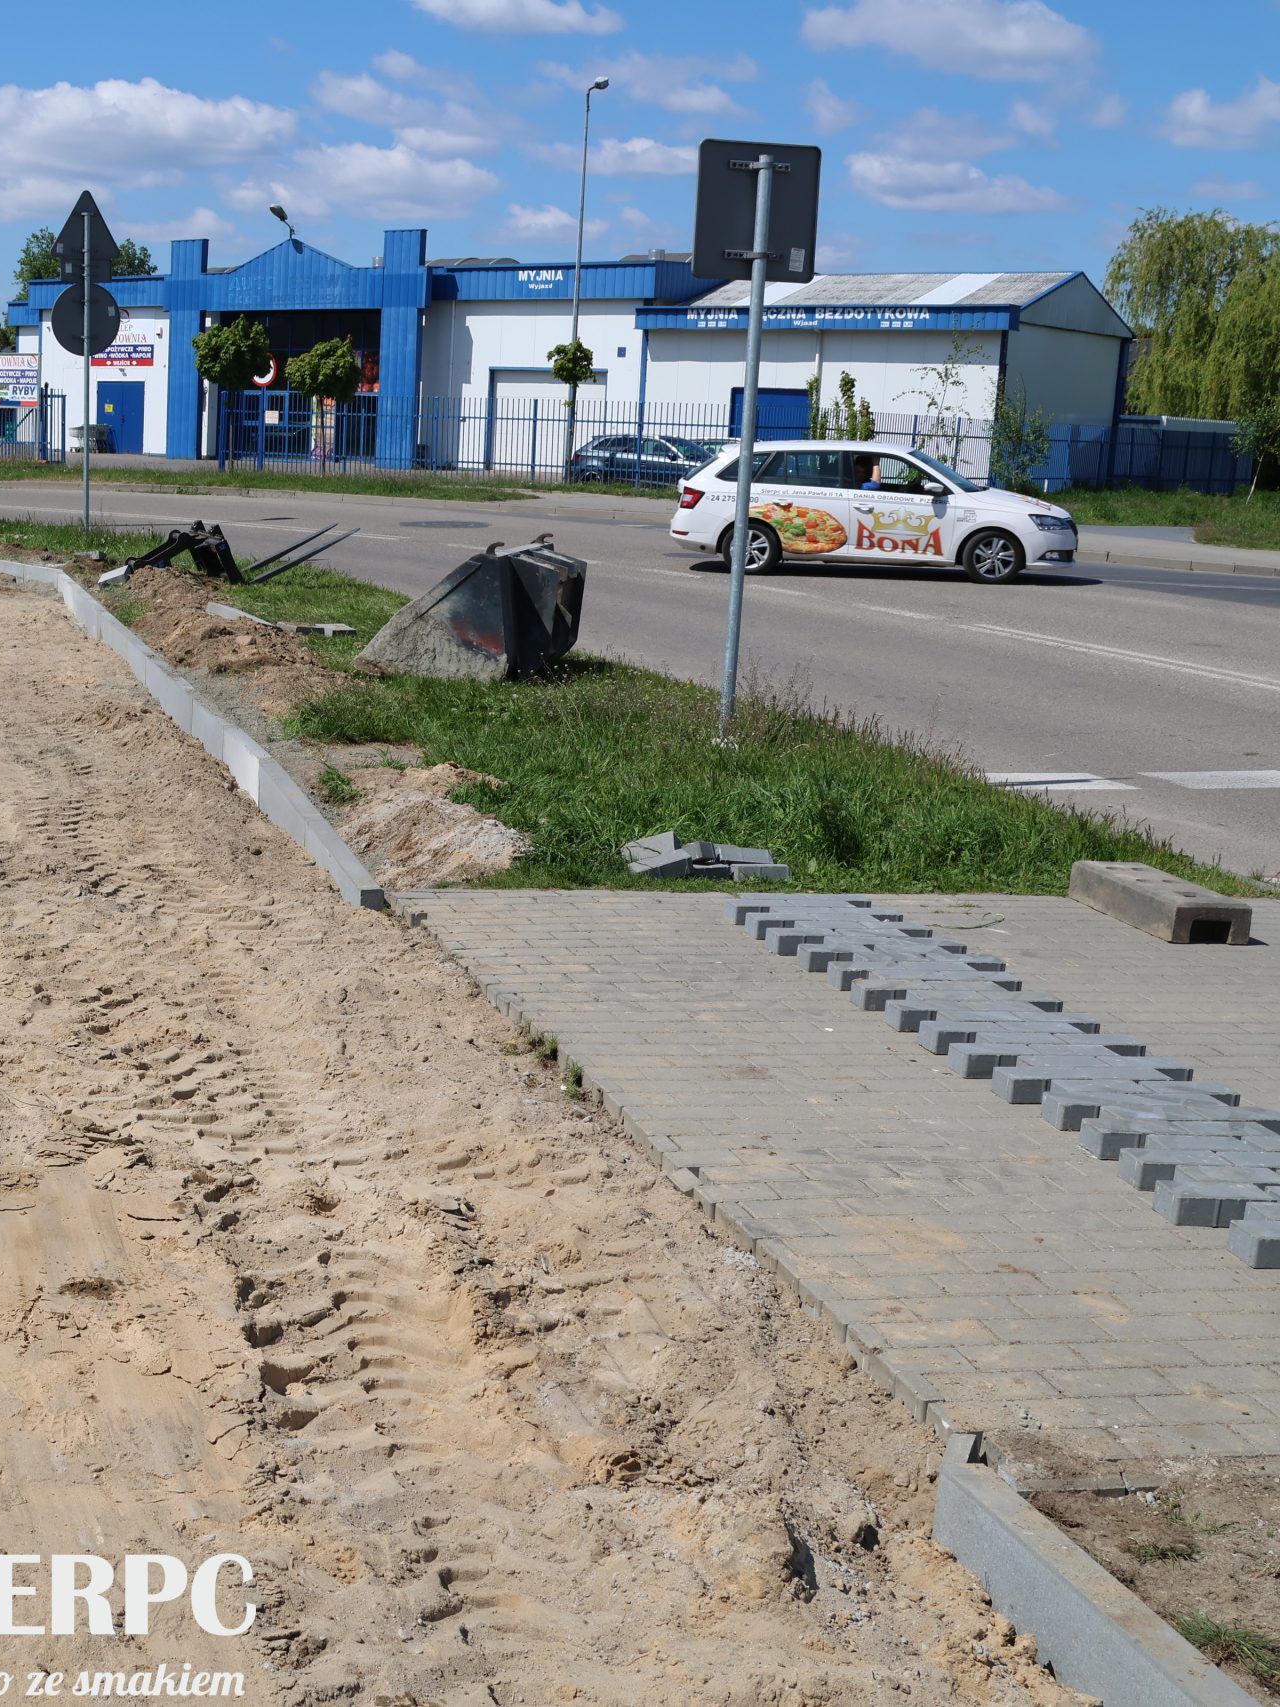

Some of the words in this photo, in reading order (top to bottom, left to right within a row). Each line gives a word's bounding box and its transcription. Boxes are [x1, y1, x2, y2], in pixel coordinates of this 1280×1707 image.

[518, 269, 563, 281] MYJNIA
[687, 308, 738, 320] MYJNIA
[762, 307, 806, 322] ĘCZNA
[815, 307, 930, 319] BEZDOTYKOWA
[115, 333, 147, 343] TOWNIA
[11, 385, 36, 395] RYBY
[877, 495, 915, 503] OBIADOWE
[854, 518, 945, 557] BONA
